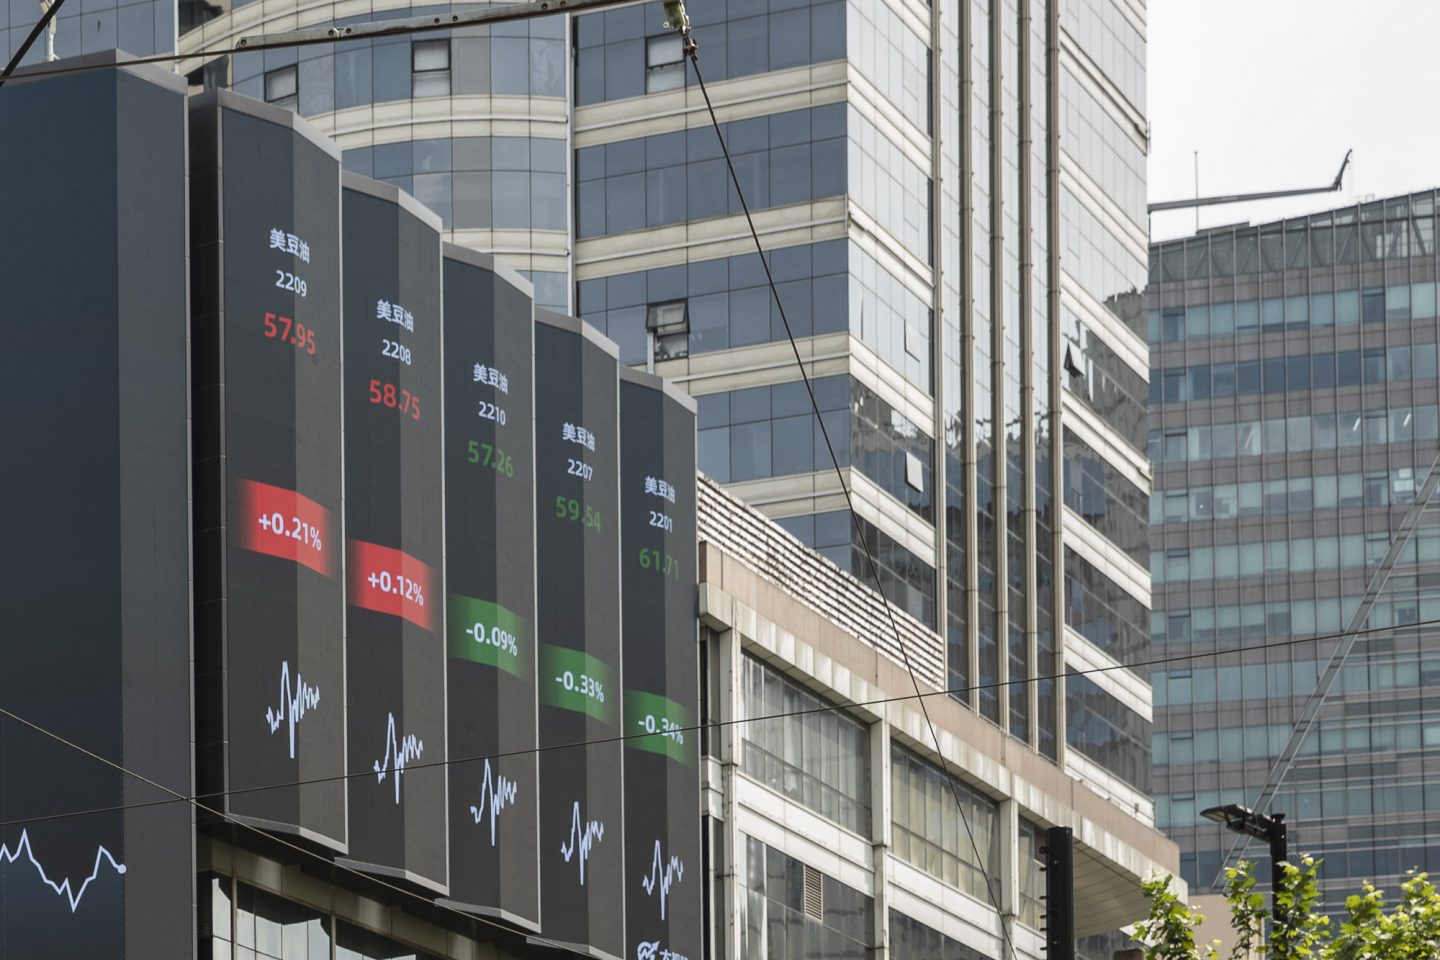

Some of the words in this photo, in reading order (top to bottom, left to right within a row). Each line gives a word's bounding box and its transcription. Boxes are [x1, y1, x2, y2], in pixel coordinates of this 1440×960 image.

[269, 228, 310, 264] 美豆油
[276, 270, 307, 297] 2209
[376, 299, 414, 333] 美豆油
[263, 312, 316, 356] 57.95
[381, 339, 412, 366] 2208
[473, 363, 508, 395] 美豆油
[369, 379, 421, 421] 58.75
[478, 401, 506, 426] 2210
[562, 422, 595, 452] 美豆油
[467, 440, 514, 479] 57.26
[567, 459, 593, 482] 2207
[645, 475, 676, 504] 美豆油
[258, 511, 322, 552] +0.21%
[556, 496, 601, 533] 59.54
[649, 510, 673, 533] 2201
[639, 546, 679, 580] 61.71
[368, 570, 424, 606] +0.12%
[466, 620, 518, 656] -0.09%
[555, 669, 605, 703] -0.33%
[638, 714, 684, 745] -0.34%
